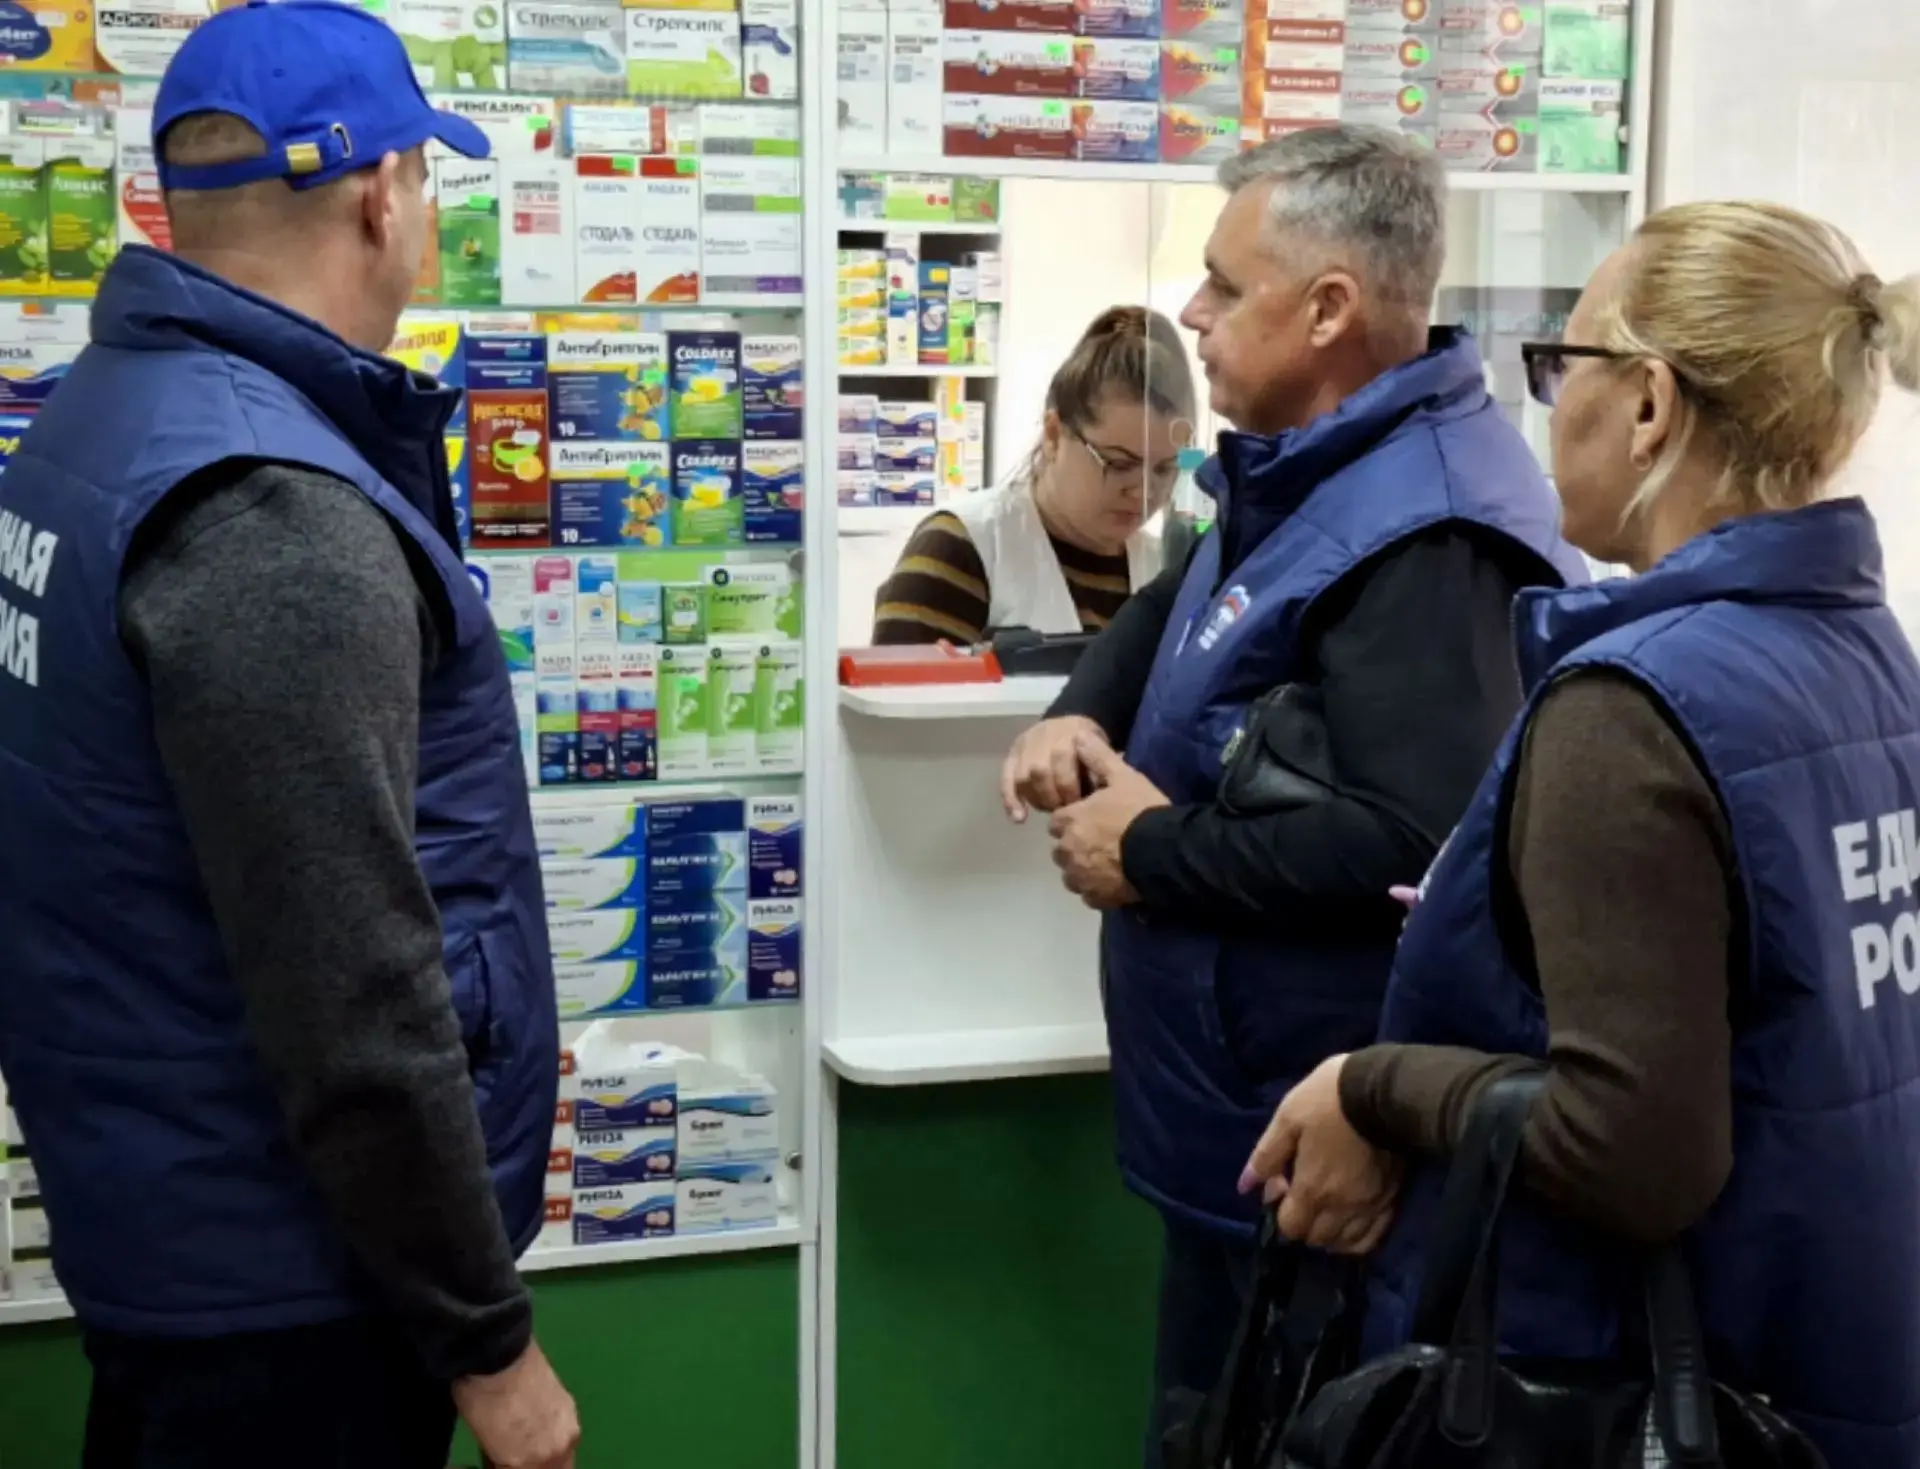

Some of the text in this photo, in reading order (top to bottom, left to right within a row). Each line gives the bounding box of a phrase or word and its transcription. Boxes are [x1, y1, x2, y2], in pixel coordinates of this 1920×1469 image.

[633, 12, 726, 33] Стрепсилс
[557, 421, 576, 436] 10
[560, 528, 579, 543] 10
